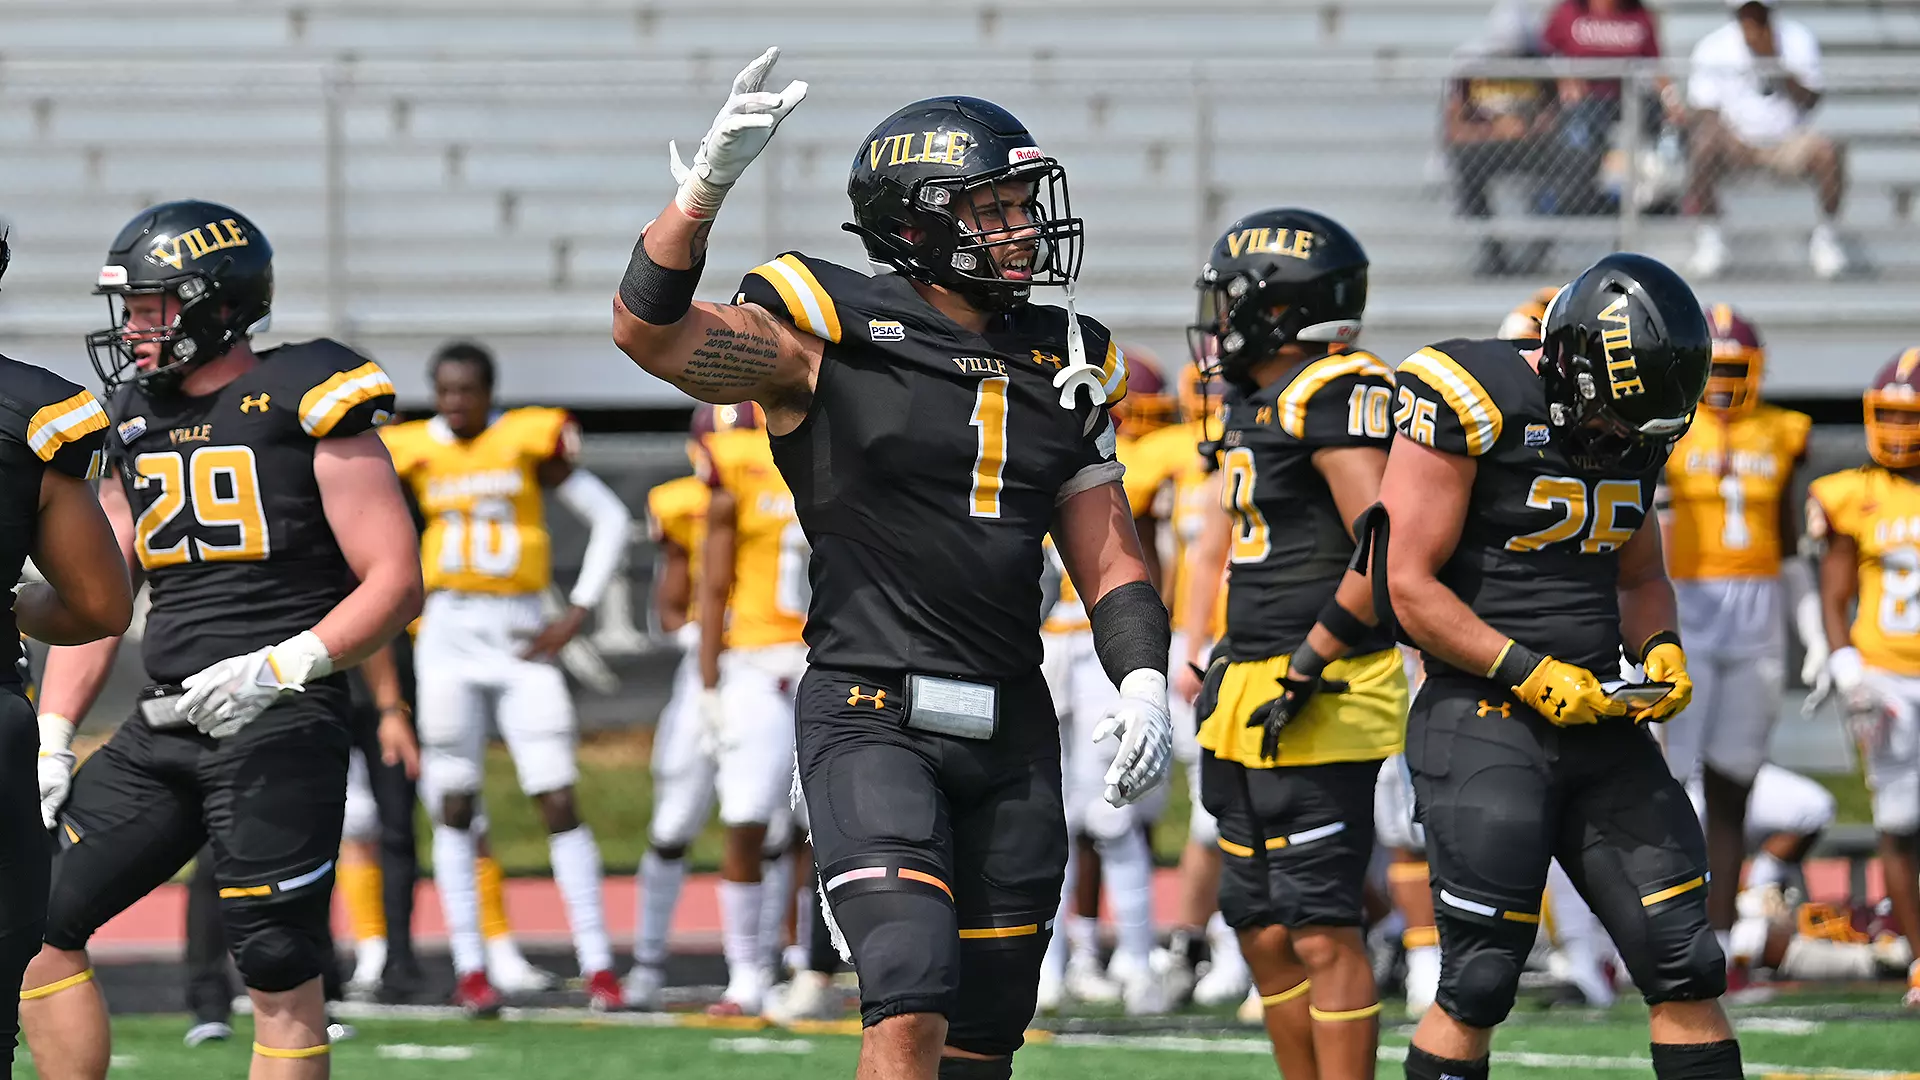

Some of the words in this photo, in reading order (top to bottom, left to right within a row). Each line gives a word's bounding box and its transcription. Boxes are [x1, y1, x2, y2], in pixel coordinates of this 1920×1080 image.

[869, 130, 972, 172] VILLE
[150, 218, 249, 270] VILLE
[1227, 227, 1314, 260] VILLE
[871, 326, 902, 336] PSAC
[1597, 294, 1646, 400] VILLE
[953, 357, 1008, 376] VILLE
[169, 424, 212, 444] VILLE
[1348, 384, 1392, 438] 10
[1394, 385, 1437, 447] 26
[969, 377, 1009, 518] 1
[134, 445, 270, 569] 29
[1504, 475, 1645, 553] 26
[1718, 474, 1751, 549] 1
[438, 497, 522, 577] 10
